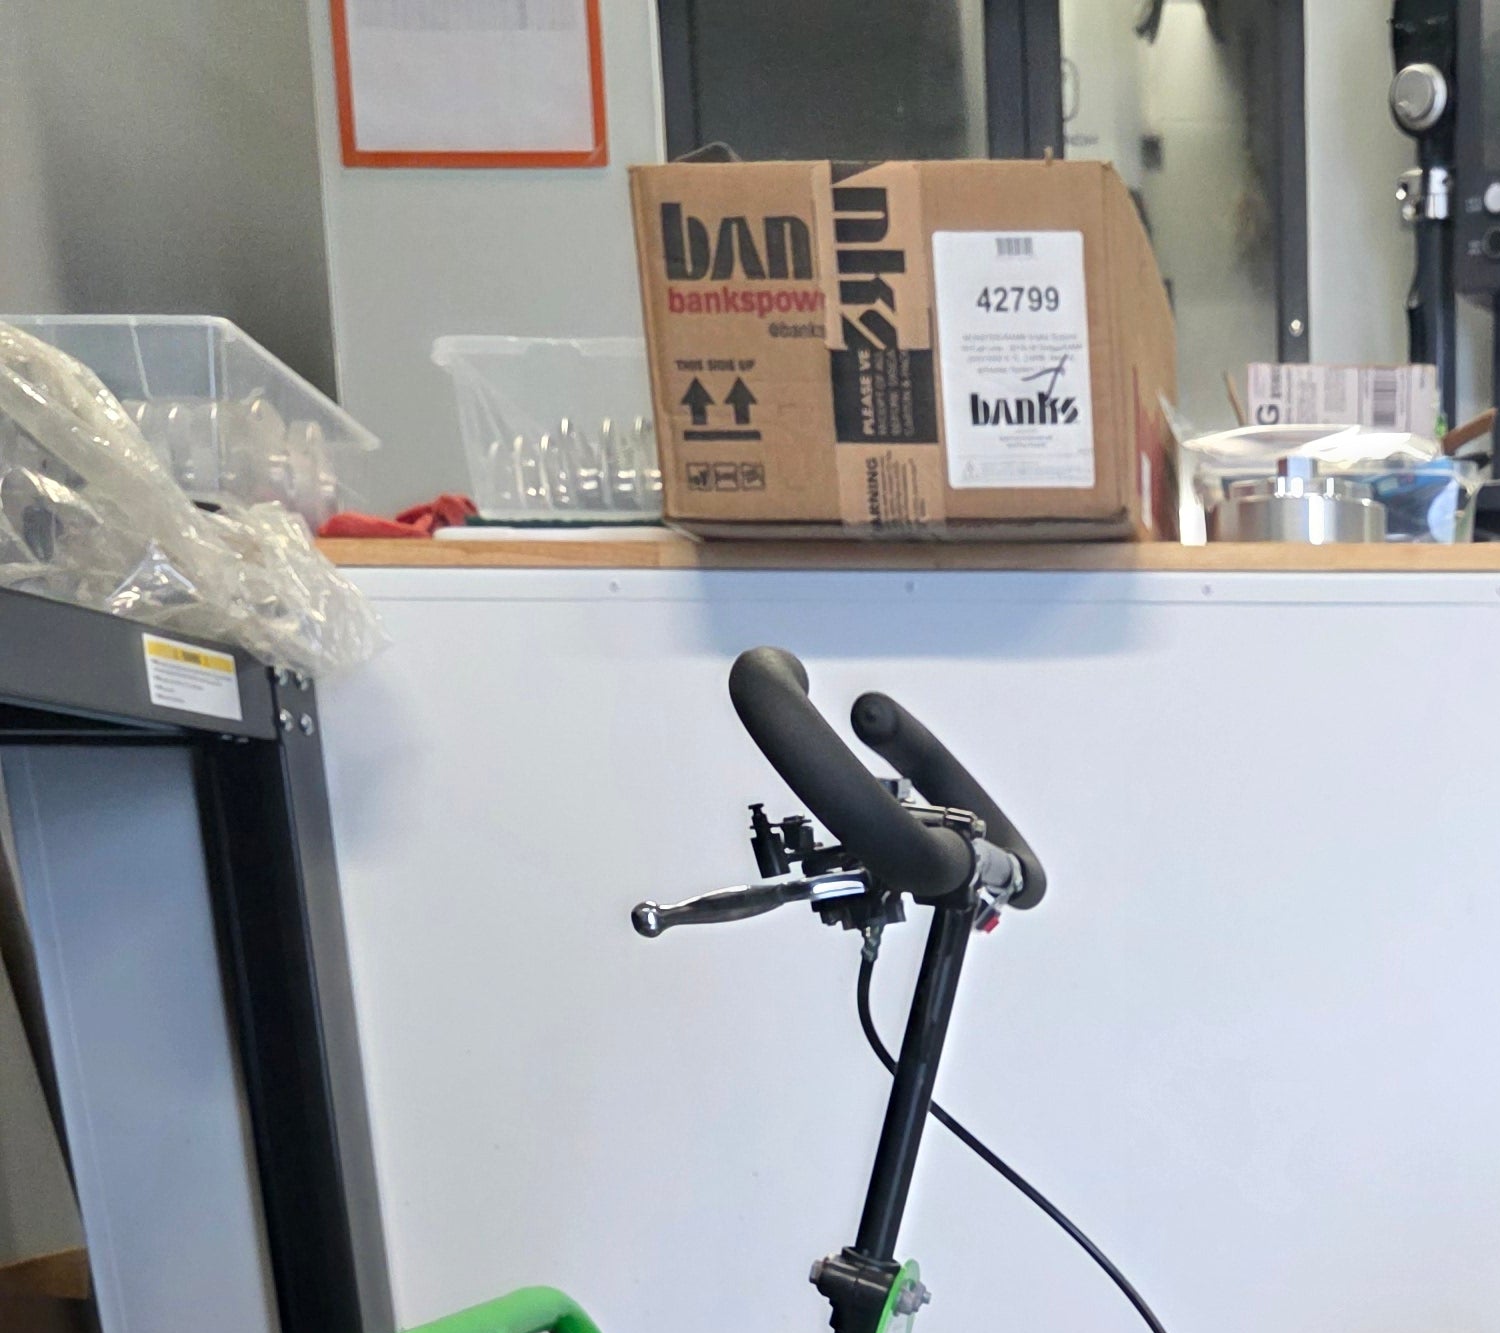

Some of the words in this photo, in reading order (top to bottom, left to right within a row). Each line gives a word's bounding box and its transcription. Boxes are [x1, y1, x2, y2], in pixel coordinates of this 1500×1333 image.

[667, 286, 826, 319] bankspow
[976, 286, 1061, 313] 42799
[856, 348, 872, 371] VE
[858, 375, 876, 436] PLEASE
